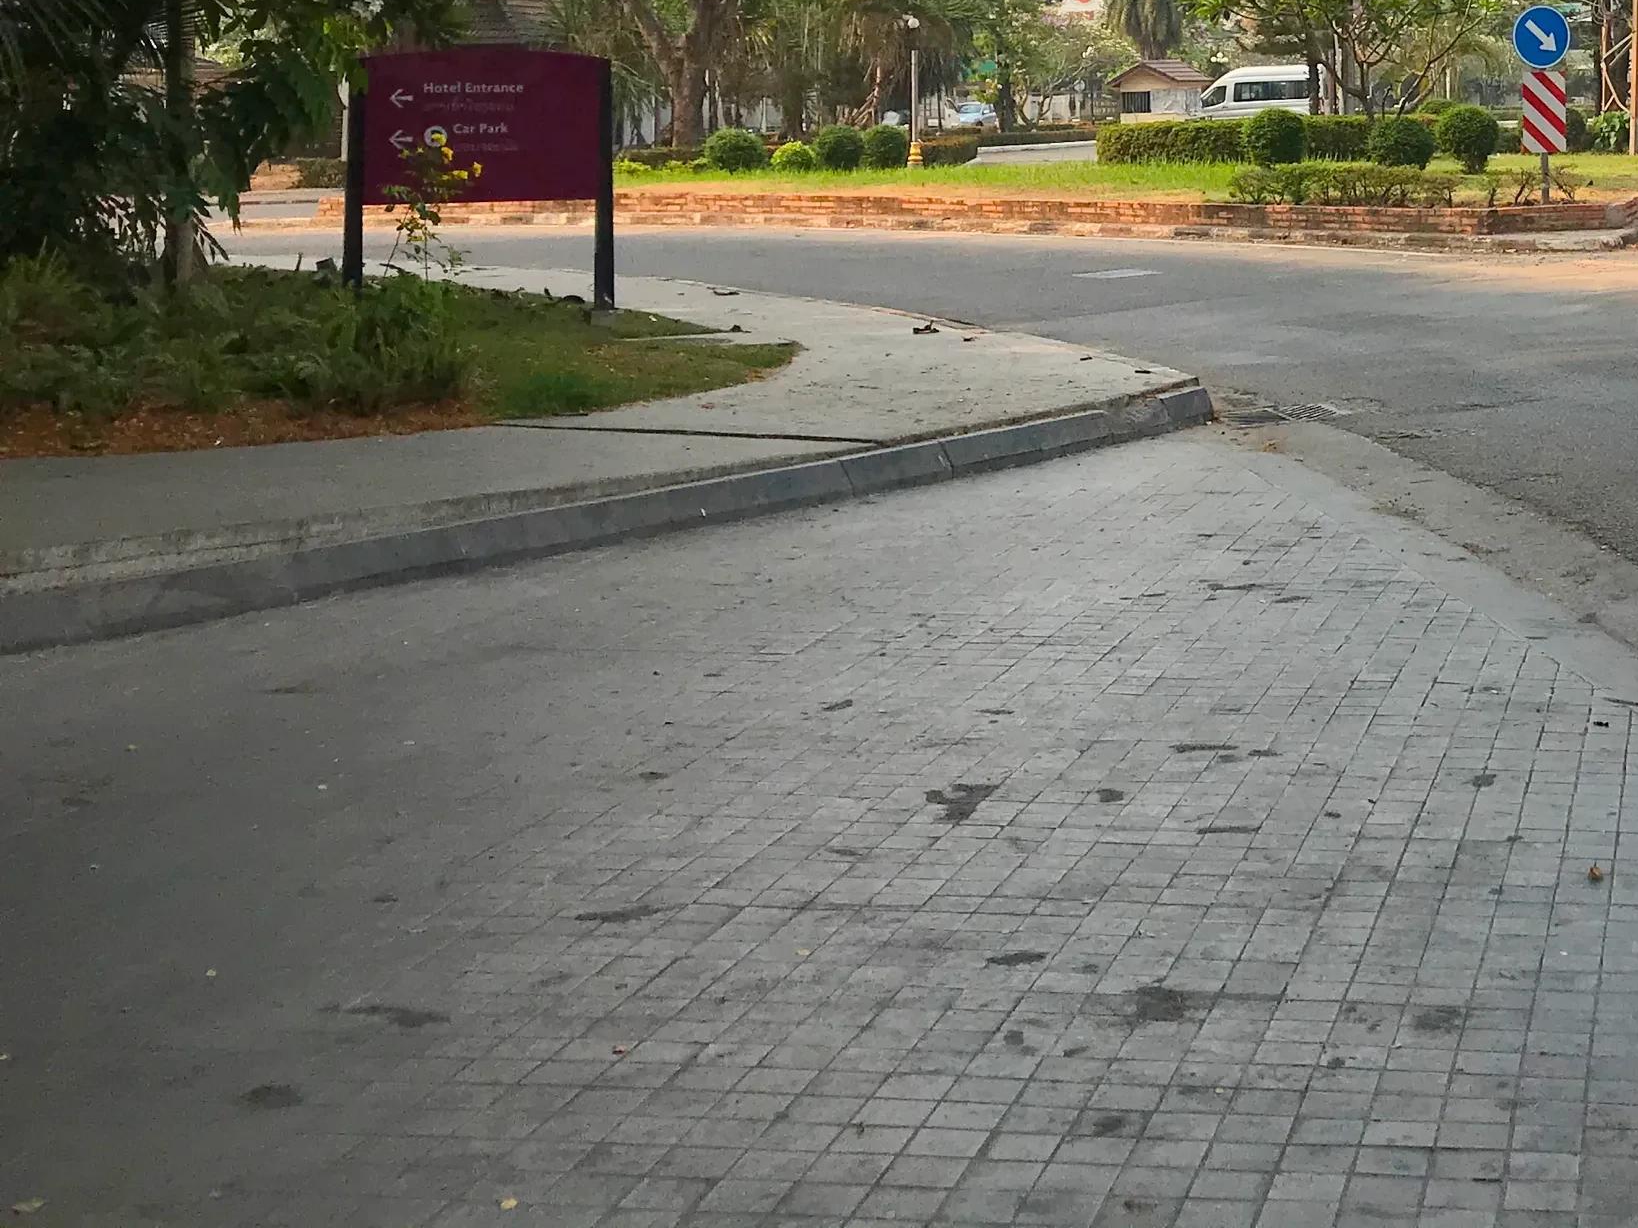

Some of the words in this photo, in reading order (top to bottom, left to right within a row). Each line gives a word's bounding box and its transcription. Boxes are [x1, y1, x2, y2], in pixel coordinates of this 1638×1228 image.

[423, 81, 461, 93] Hotel
[464, 82, 524, 93] Entrance
[453, 123, 475, 134] Car
[479, 121, 509, 133] Park
